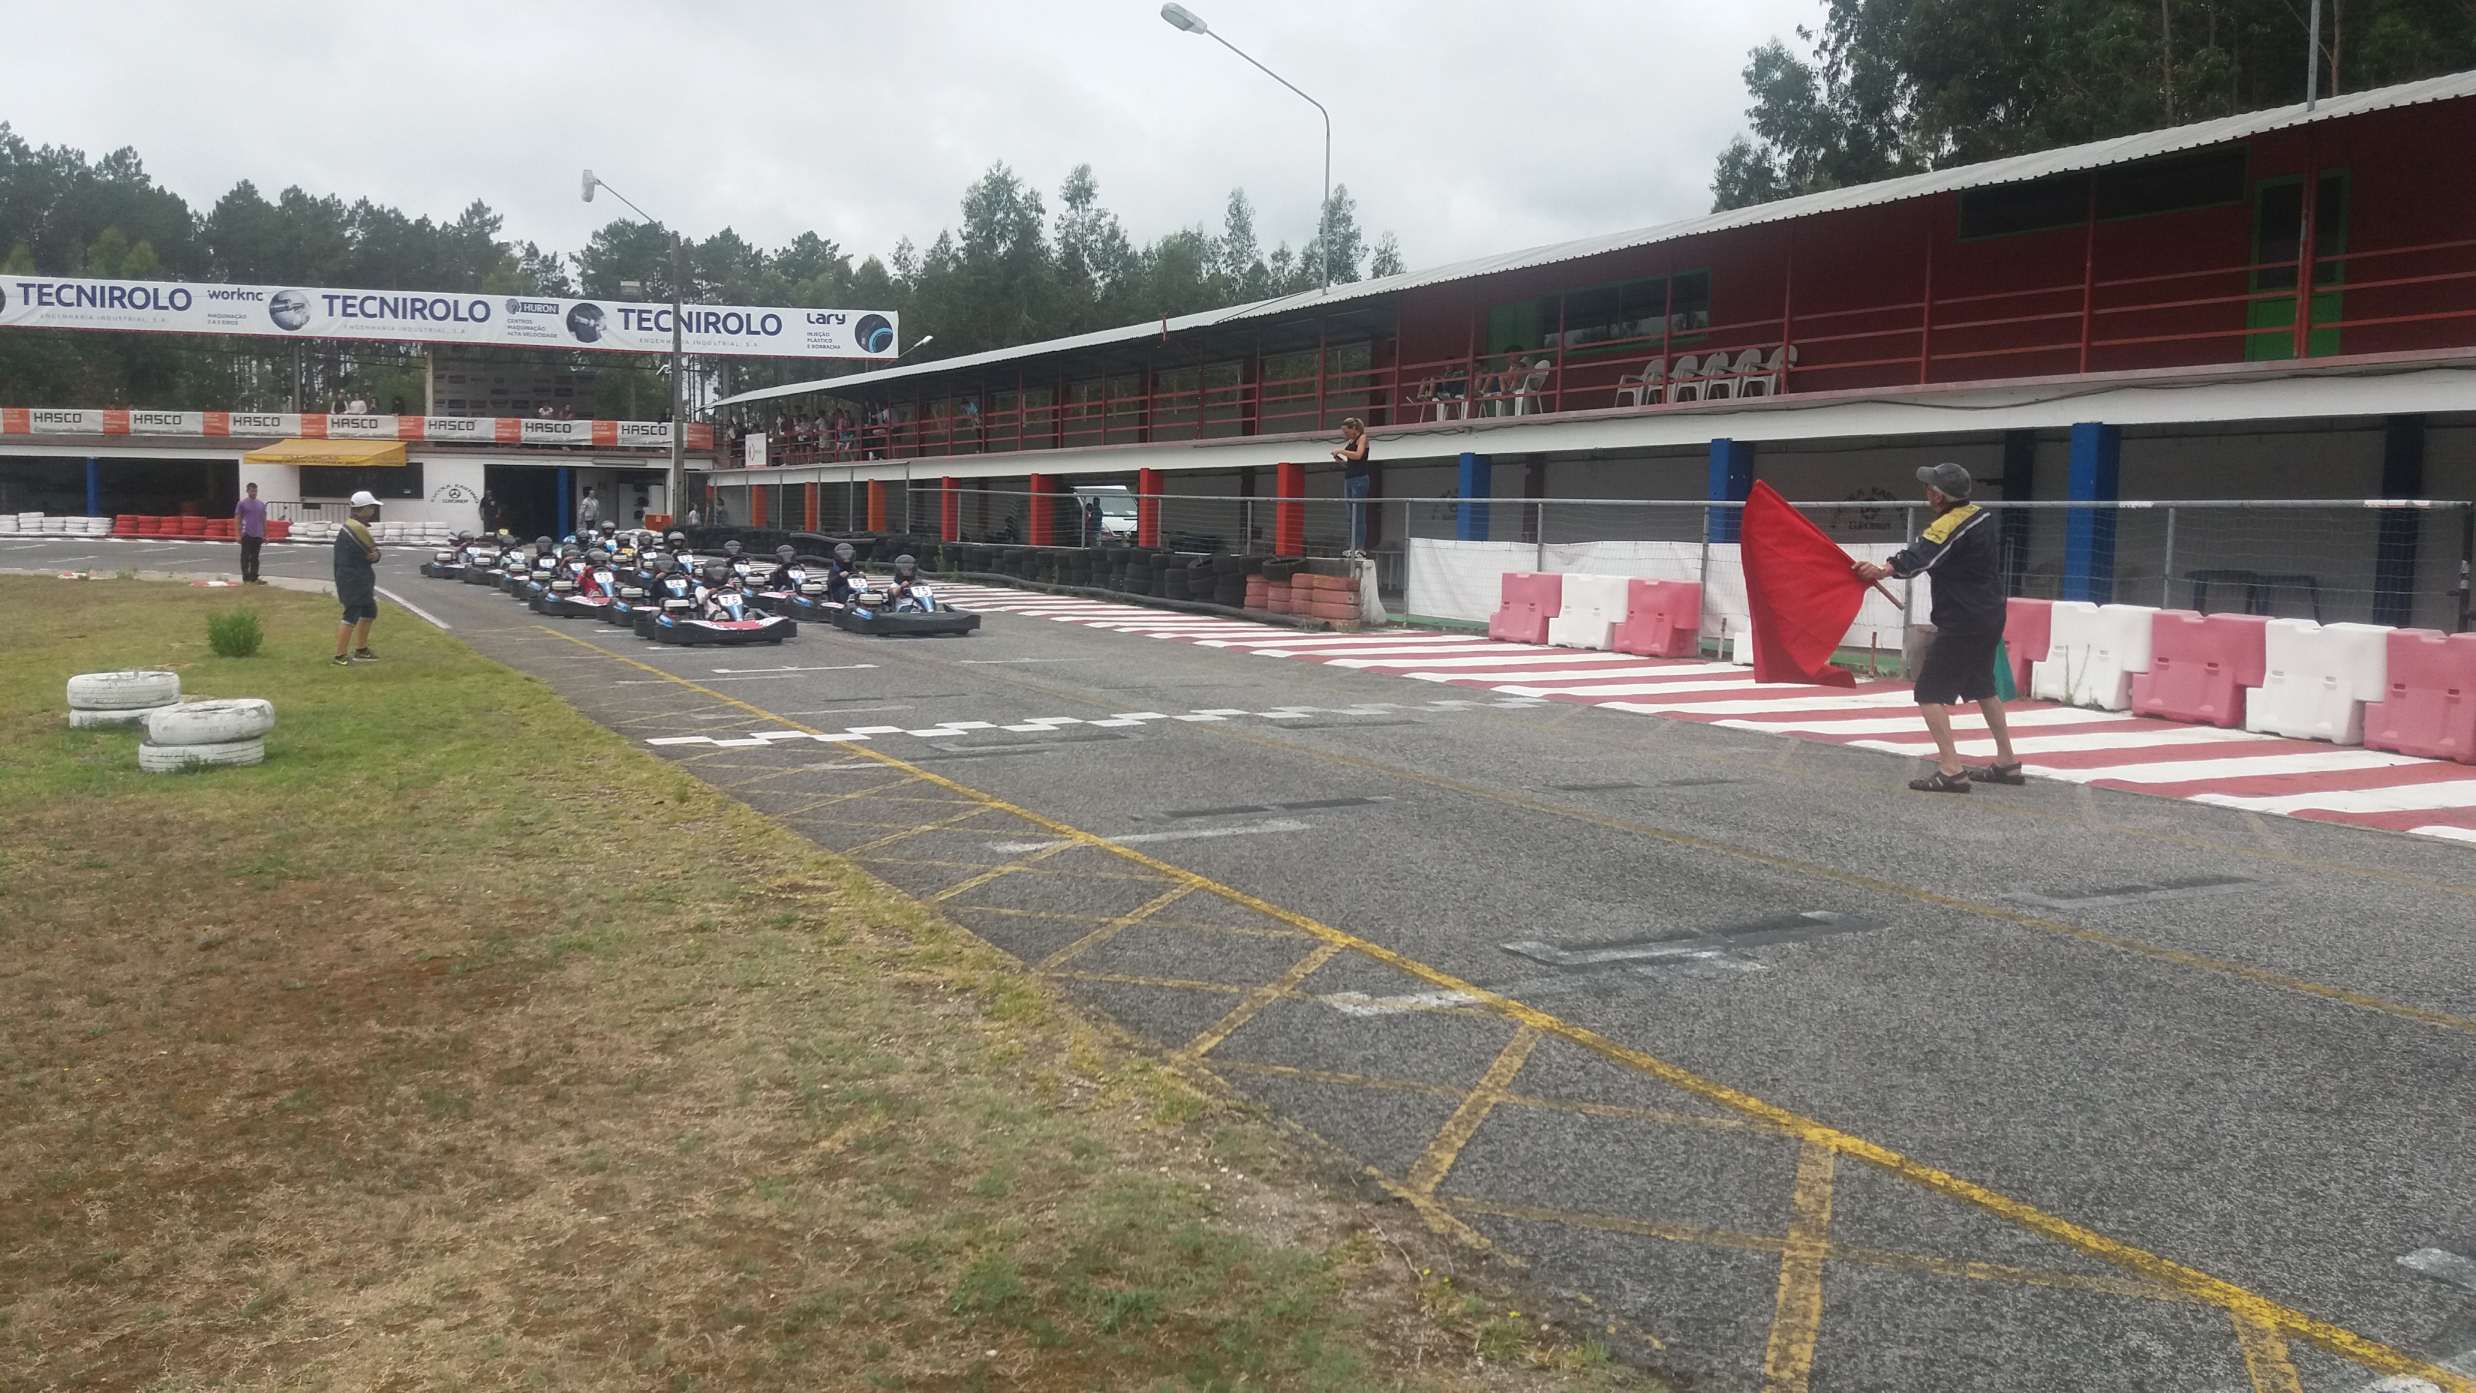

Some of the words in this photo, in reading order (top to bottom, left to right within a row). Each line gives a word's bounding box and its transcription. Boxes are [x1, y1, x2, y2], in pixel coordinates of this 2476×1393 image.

[16, 283, 192, 311] TECNIROLO
[208, 288, 264, 301] worknc
[322, 294, 491, 322] TECNIROLO
[523, 303, 557, 313] HURON
[617, 308, 783, 337] TECNIROLO
[34, 412, 82, 424] HASCO
[133, 413, 182, 425] HASCO
[233, 416, 281, 427] HASCO
[331, 418, 378, 429] HASCO
[428, 420, 476, 431] HASCO
[525, 422, 572, 434] HASCO
[621, 425, 668, 436] HASCO
